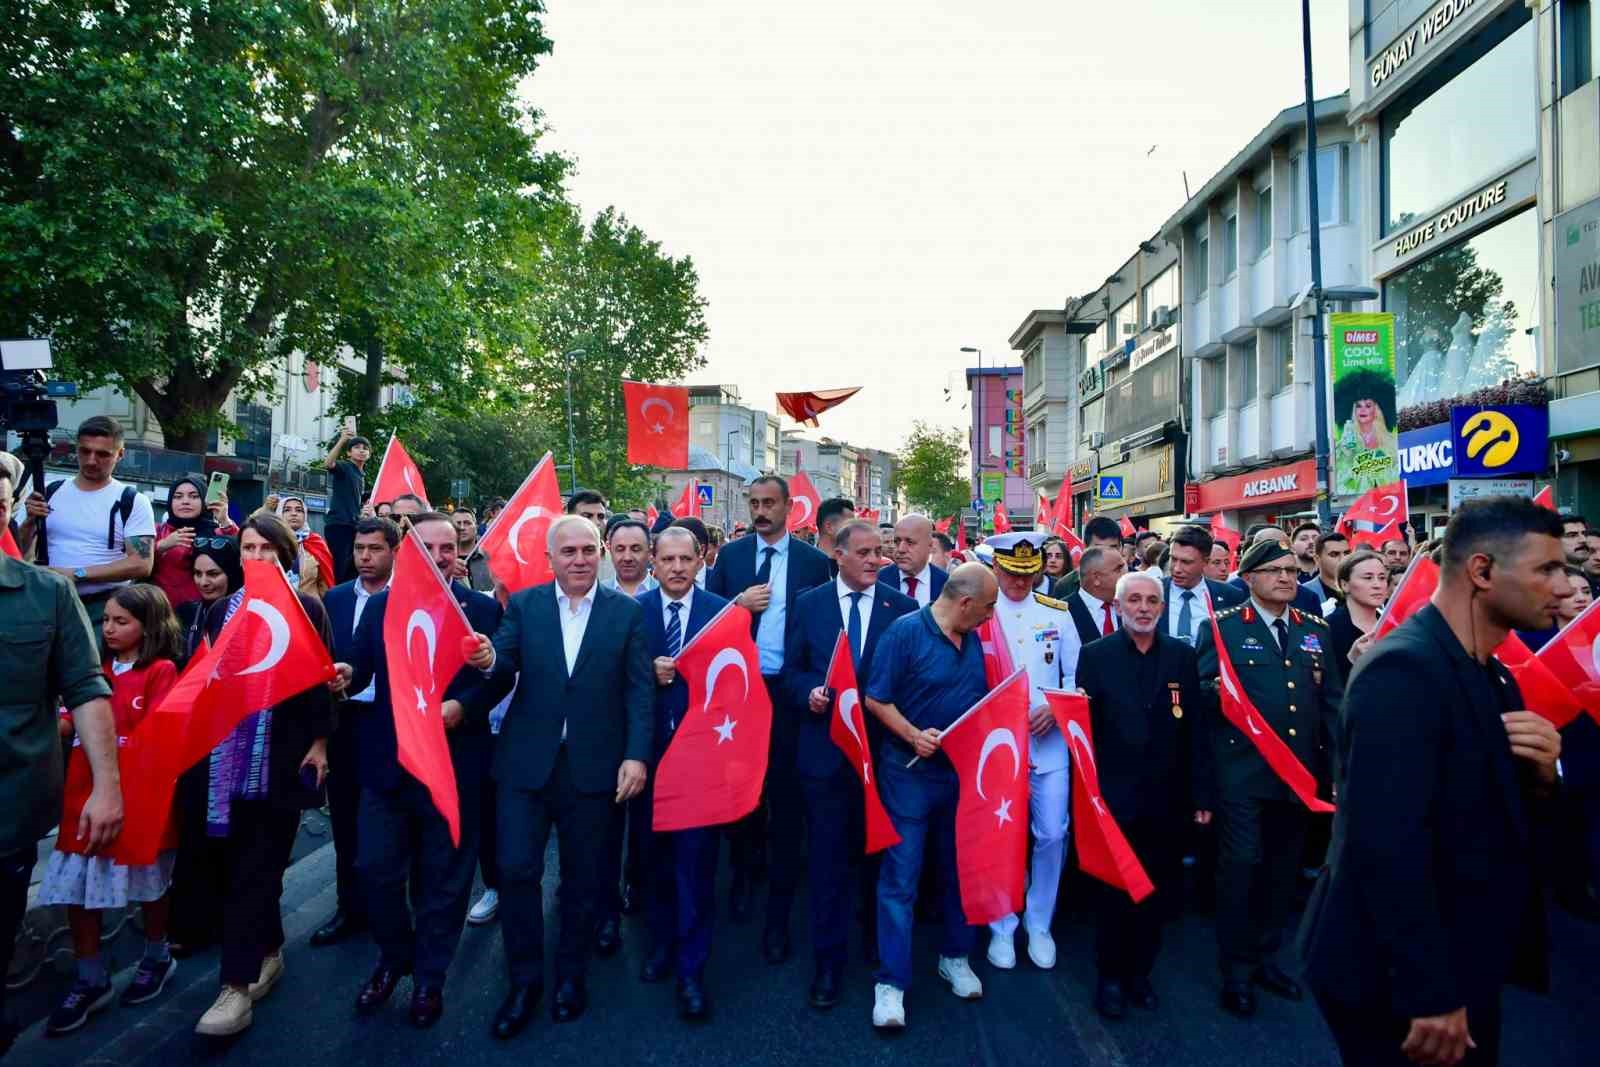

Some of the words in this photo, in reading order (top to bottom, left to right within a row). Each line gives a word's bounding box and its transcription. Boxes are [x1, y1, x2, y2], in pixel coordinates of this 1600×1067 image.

[1372, 30, 1417, 88] GÜNAY
[1394, 221, 1435, 257] HAUTE
[1438, 181, 1506, 232] COUTURE
[1344, 346, 1380, 358] COOL
[1243, 474, 1297, 497] AKBANK
